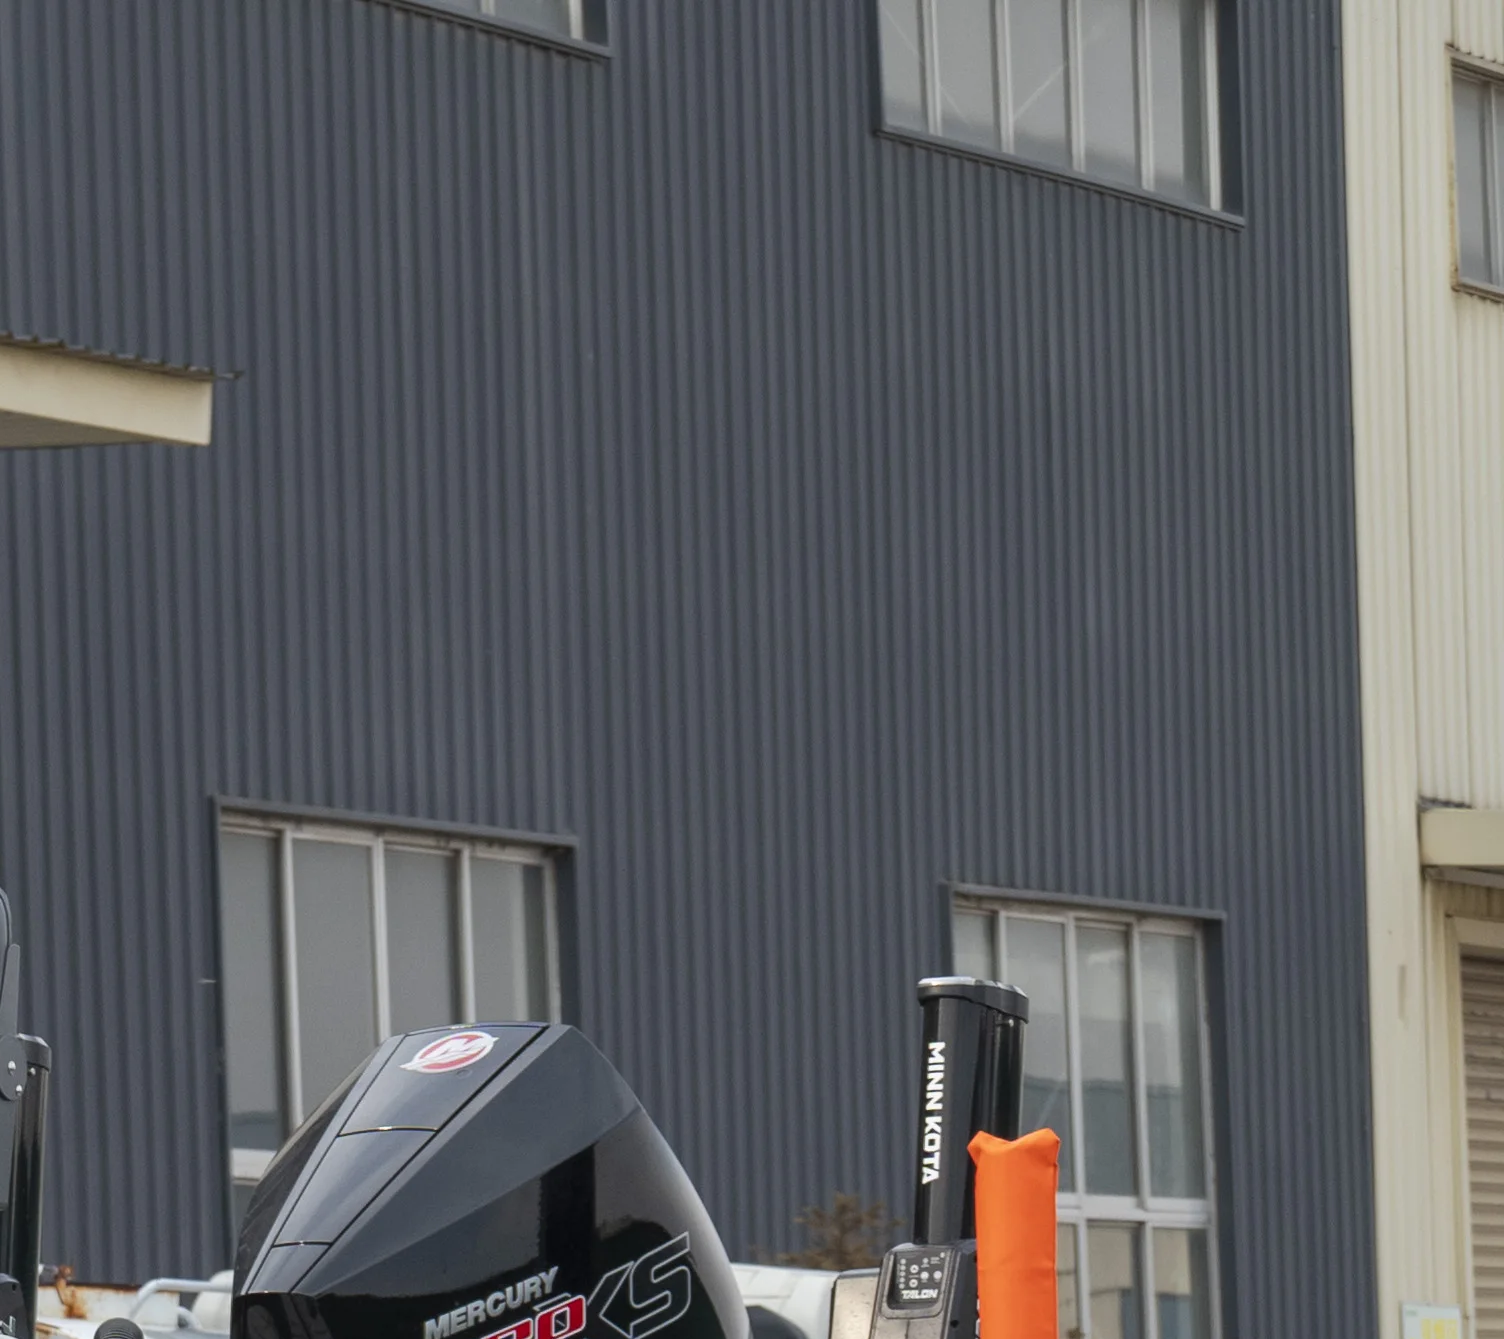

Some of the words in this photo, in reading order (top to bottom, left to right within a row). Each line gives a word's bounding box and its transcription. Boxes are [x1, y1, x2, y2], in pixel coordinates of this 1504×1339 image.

[926, 1041, 946, 1111] MINN
[921, 1116, 943, 1185] KOTA
[901, 1288, 939, 1300] TALON
